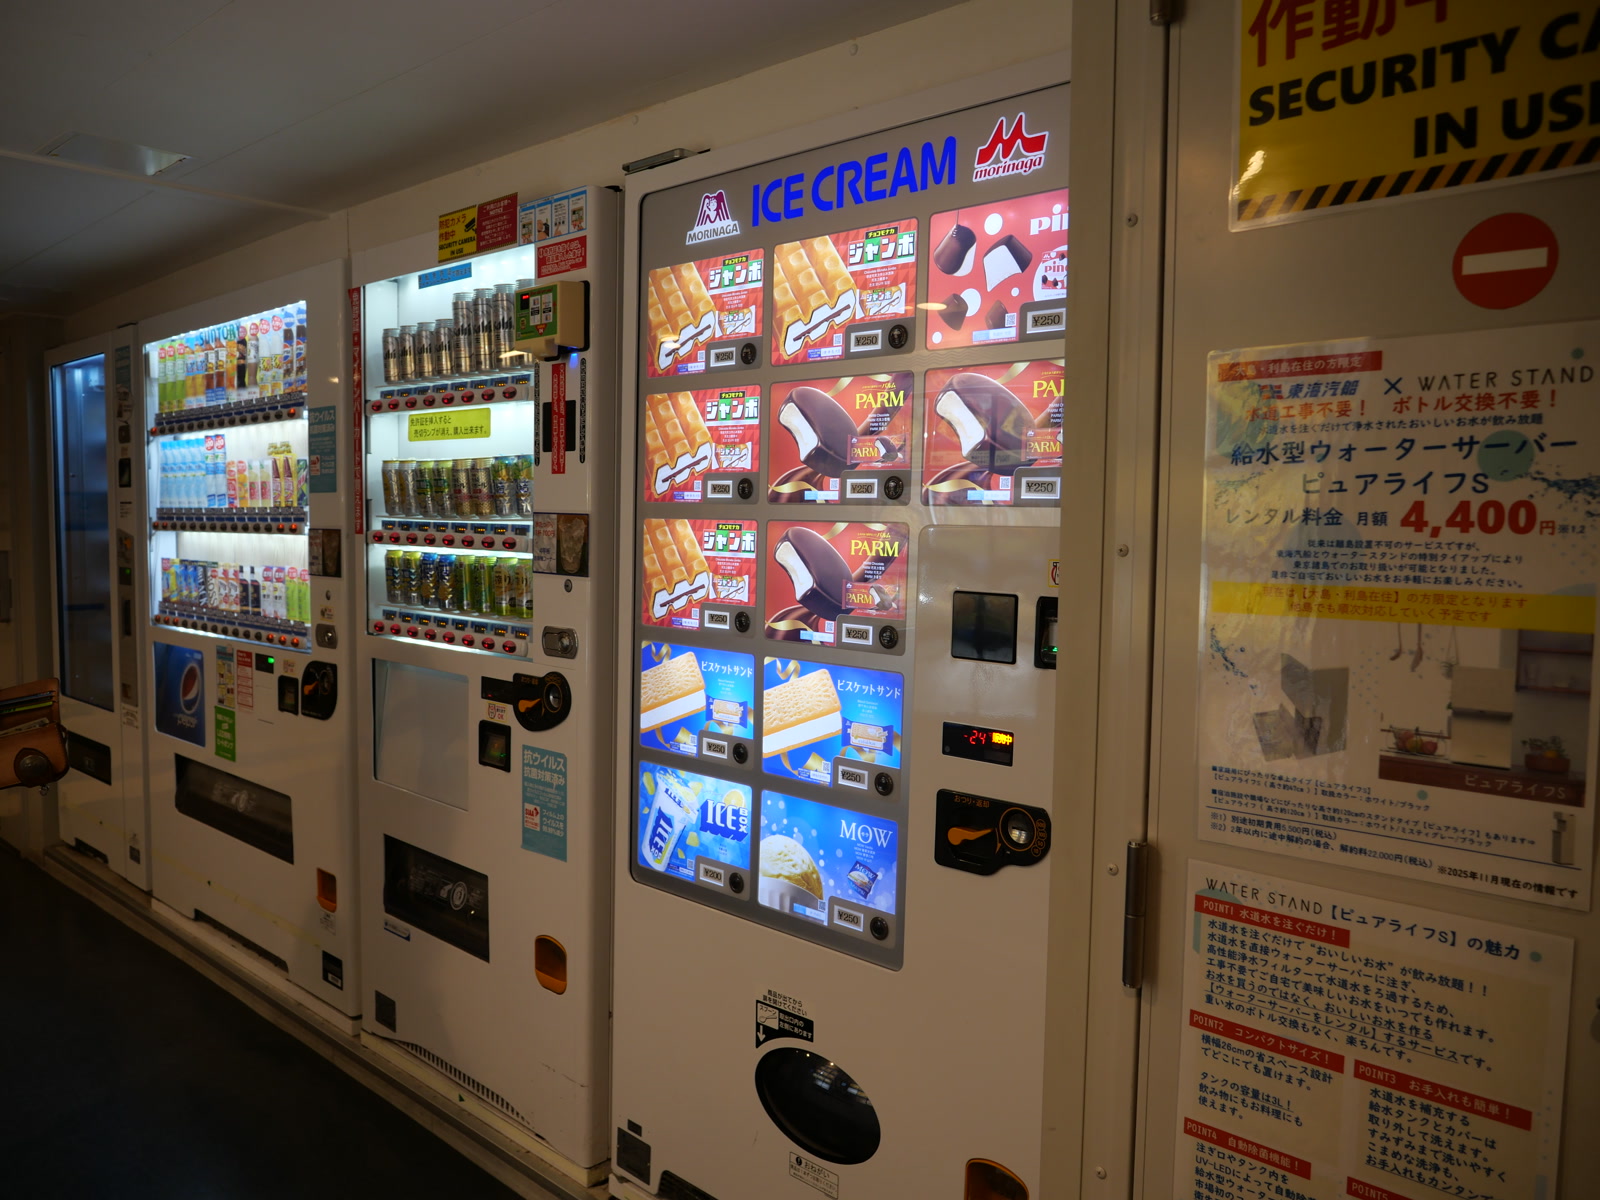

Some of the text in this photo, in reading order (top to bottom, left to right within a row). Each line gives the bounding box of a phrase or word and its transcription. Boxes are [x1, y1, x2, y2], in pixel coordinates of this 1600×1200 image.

[1249, 25, 1520, 126] SECURITY
[1413, 106, 1478, 158] IN
[972, 155, 1045, 181] morinaga
[751, 135, 957, 226] ICE CREAM
[687, 223, 740, 243] MORINAGA
[849, 233, 915, 265] ジャンボ
[709, 261, 762, 288] ジャンボ
[1032, 314, 1060, 327] ¥250
[855, 335, 878, 346] ¥250
[714, 351, 734, 362] ¥250
[1417, 371, 1498, 393] WATER
[1510, 365, 1595, 388] STAND
[706, 398, 759, 420] ジャンボ
[855, 390, 905, 409] PARM
[1230, 432, 1578, 466] 給水型ウォーターサーバー
[712, 484, 731, 493] ¥250
[851, 483, 873, 494] ¥250
[1025, 482, 1054, 493] ¥250
[1302, 471, 1489, 496] ピュアライフS
[1226, 506, 1344, 527] レンタル料金
[1356, 510, 1388, 528] 月額
[703, 531, 755, 553] ジャンボ
[850, 539, 899, 557] PARM
[709, 613, 728, 624] ¥250
[846, 628, 869, 640] ¥250
[701, 660, 753, 678] ビスケットサンド
[836, 679, 902, 699] ビスケットサンド
[707, 741, 726, 754] ¥250
[523, 749, 566, 773] 抗ウイルス
[840, 770, 861, 783] ¥250
[1464, 774, 1567, 800] ピュアライフS
[706, 798, 739, 831] ICE
[839, 819, 893, 848] MOW
[1205, 877, 1260, 901] WATER
[1267, 892, 1323, 915] STAND
[837, 910, 859, 925] ¥250
[1193, 1013, 1330, 1065] POINT2 コンパクトサイズ！
[1358, 1064, 1511, 1120] POINT3 お手入れも簡単！
[1186, 1120, 1218, 1140] POINT4
